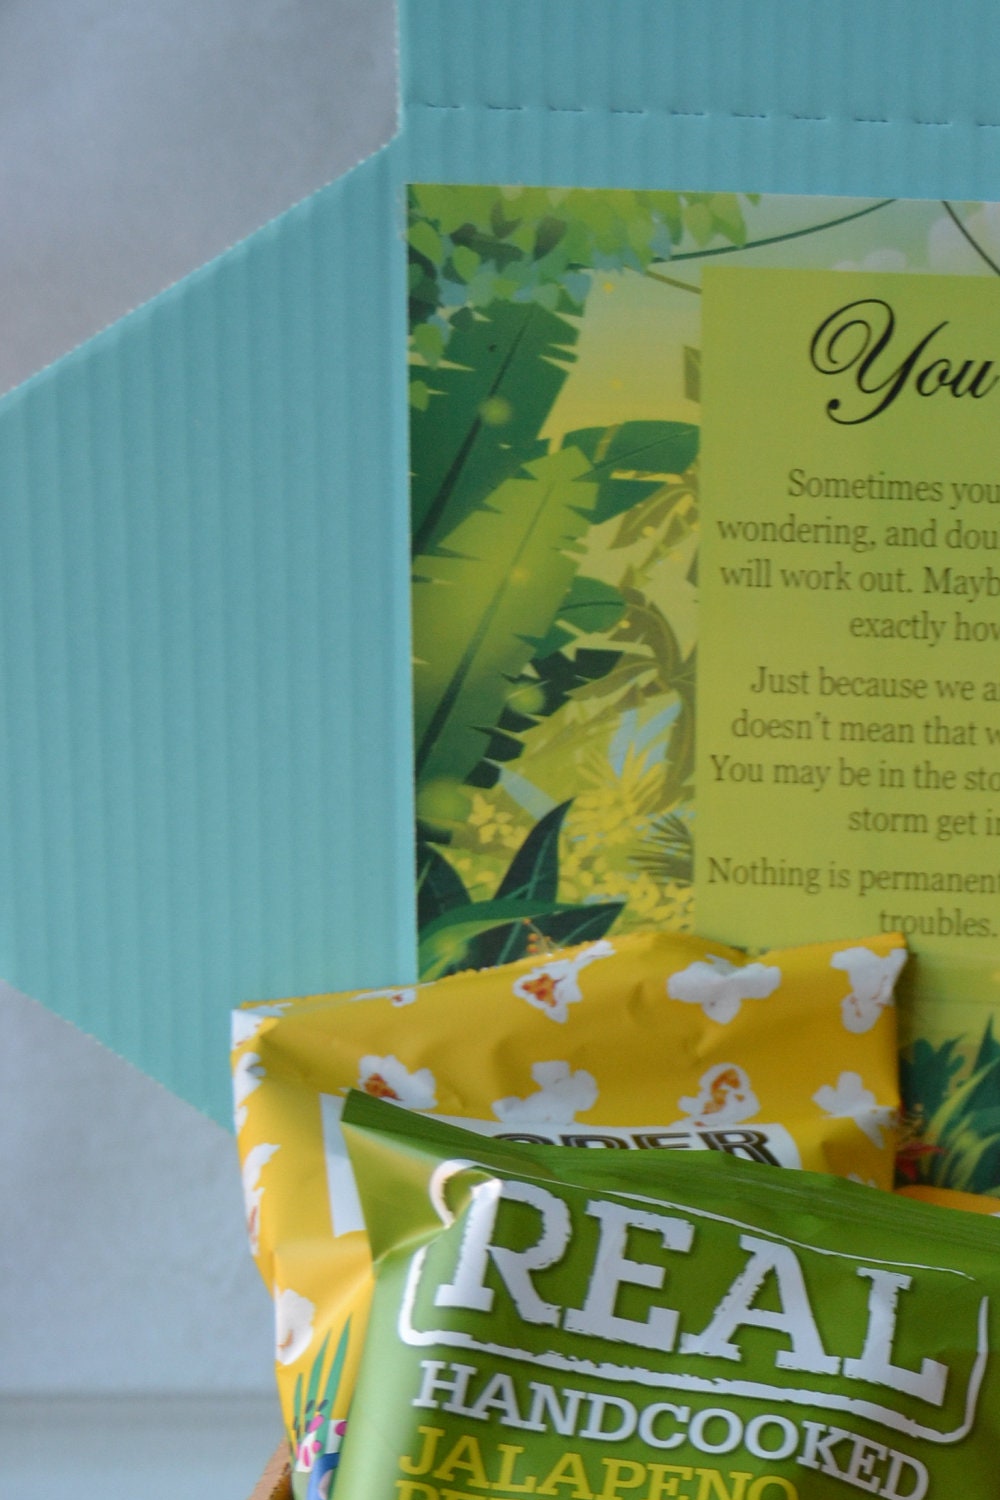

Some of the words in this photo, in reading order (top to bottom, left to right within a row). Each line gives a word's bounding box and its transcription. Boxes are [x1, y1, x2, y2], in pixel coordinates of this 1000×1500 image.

[786, 466, 944, 503] Sometimes
[715, 512, 878, 554] wondering,
[883, 516, 939, 549] and
[719, 556, 773, 589] will
[779, 560, 852, 592] work
[858, 567, 914, 594] out.
[848, 609, 948, 648] exactly
[749, 665, 811, 696] Just
[817, 664, 929, 700] because
[933, 678, 976, 701] we
[730, 706, 832, 741] doesn't
[838, 720, 915, 744] mean
[922, 713, 978, 747] that
[708, 752, 765, 784] You
[772, 762, 832, 794] may
[838, 756, 872, 788] be
[878, 758, 906, 789] in
[912, 759, 958, 791] the
[847, 807, 930, 835] storm
[934, 810, 978, 843] get
[706, 855, 822, 896] Nothing
[828, 859, 851, 890] is
[877, 905, 999, 939] troubles.
[434, 1177, 949, 1407] REAL
